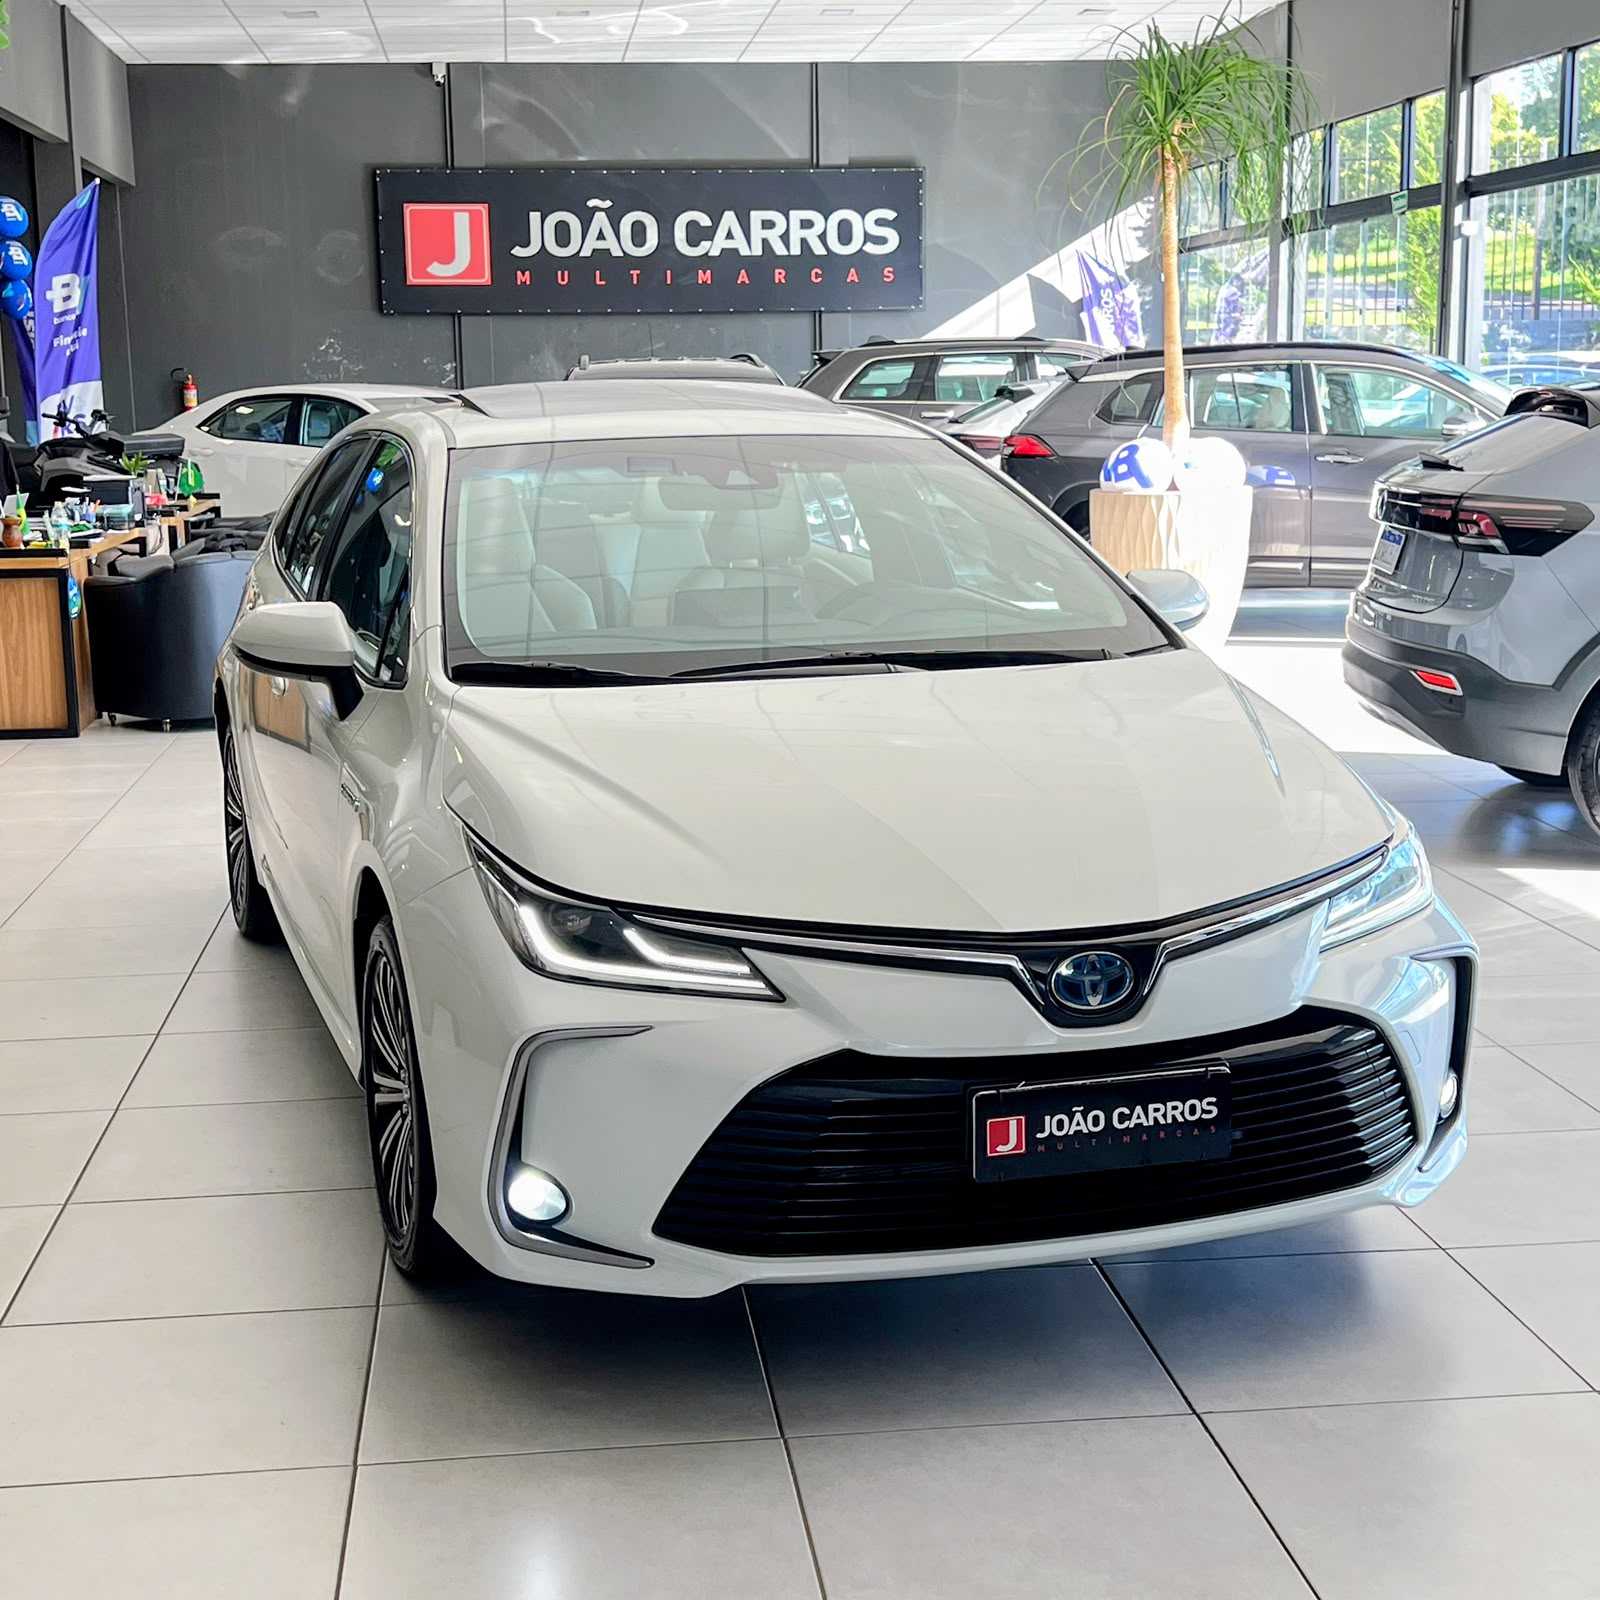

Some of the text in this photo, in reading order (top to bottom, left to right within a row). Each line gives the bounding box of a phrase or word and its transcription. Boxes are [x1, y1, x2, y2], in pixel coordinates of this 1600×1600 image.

[425, 212, 471, 277] J
[510, 198, 901, 258] JOÃO CARROS
[516, 266, 896, 286] MULTIMARCAS
[996, 1119, 1018, 1152] J
[1036, 1097, 1218, 1138] JOÃO CARROS
[1037, 1125, 1216, 1152] MULTIMARCAS
